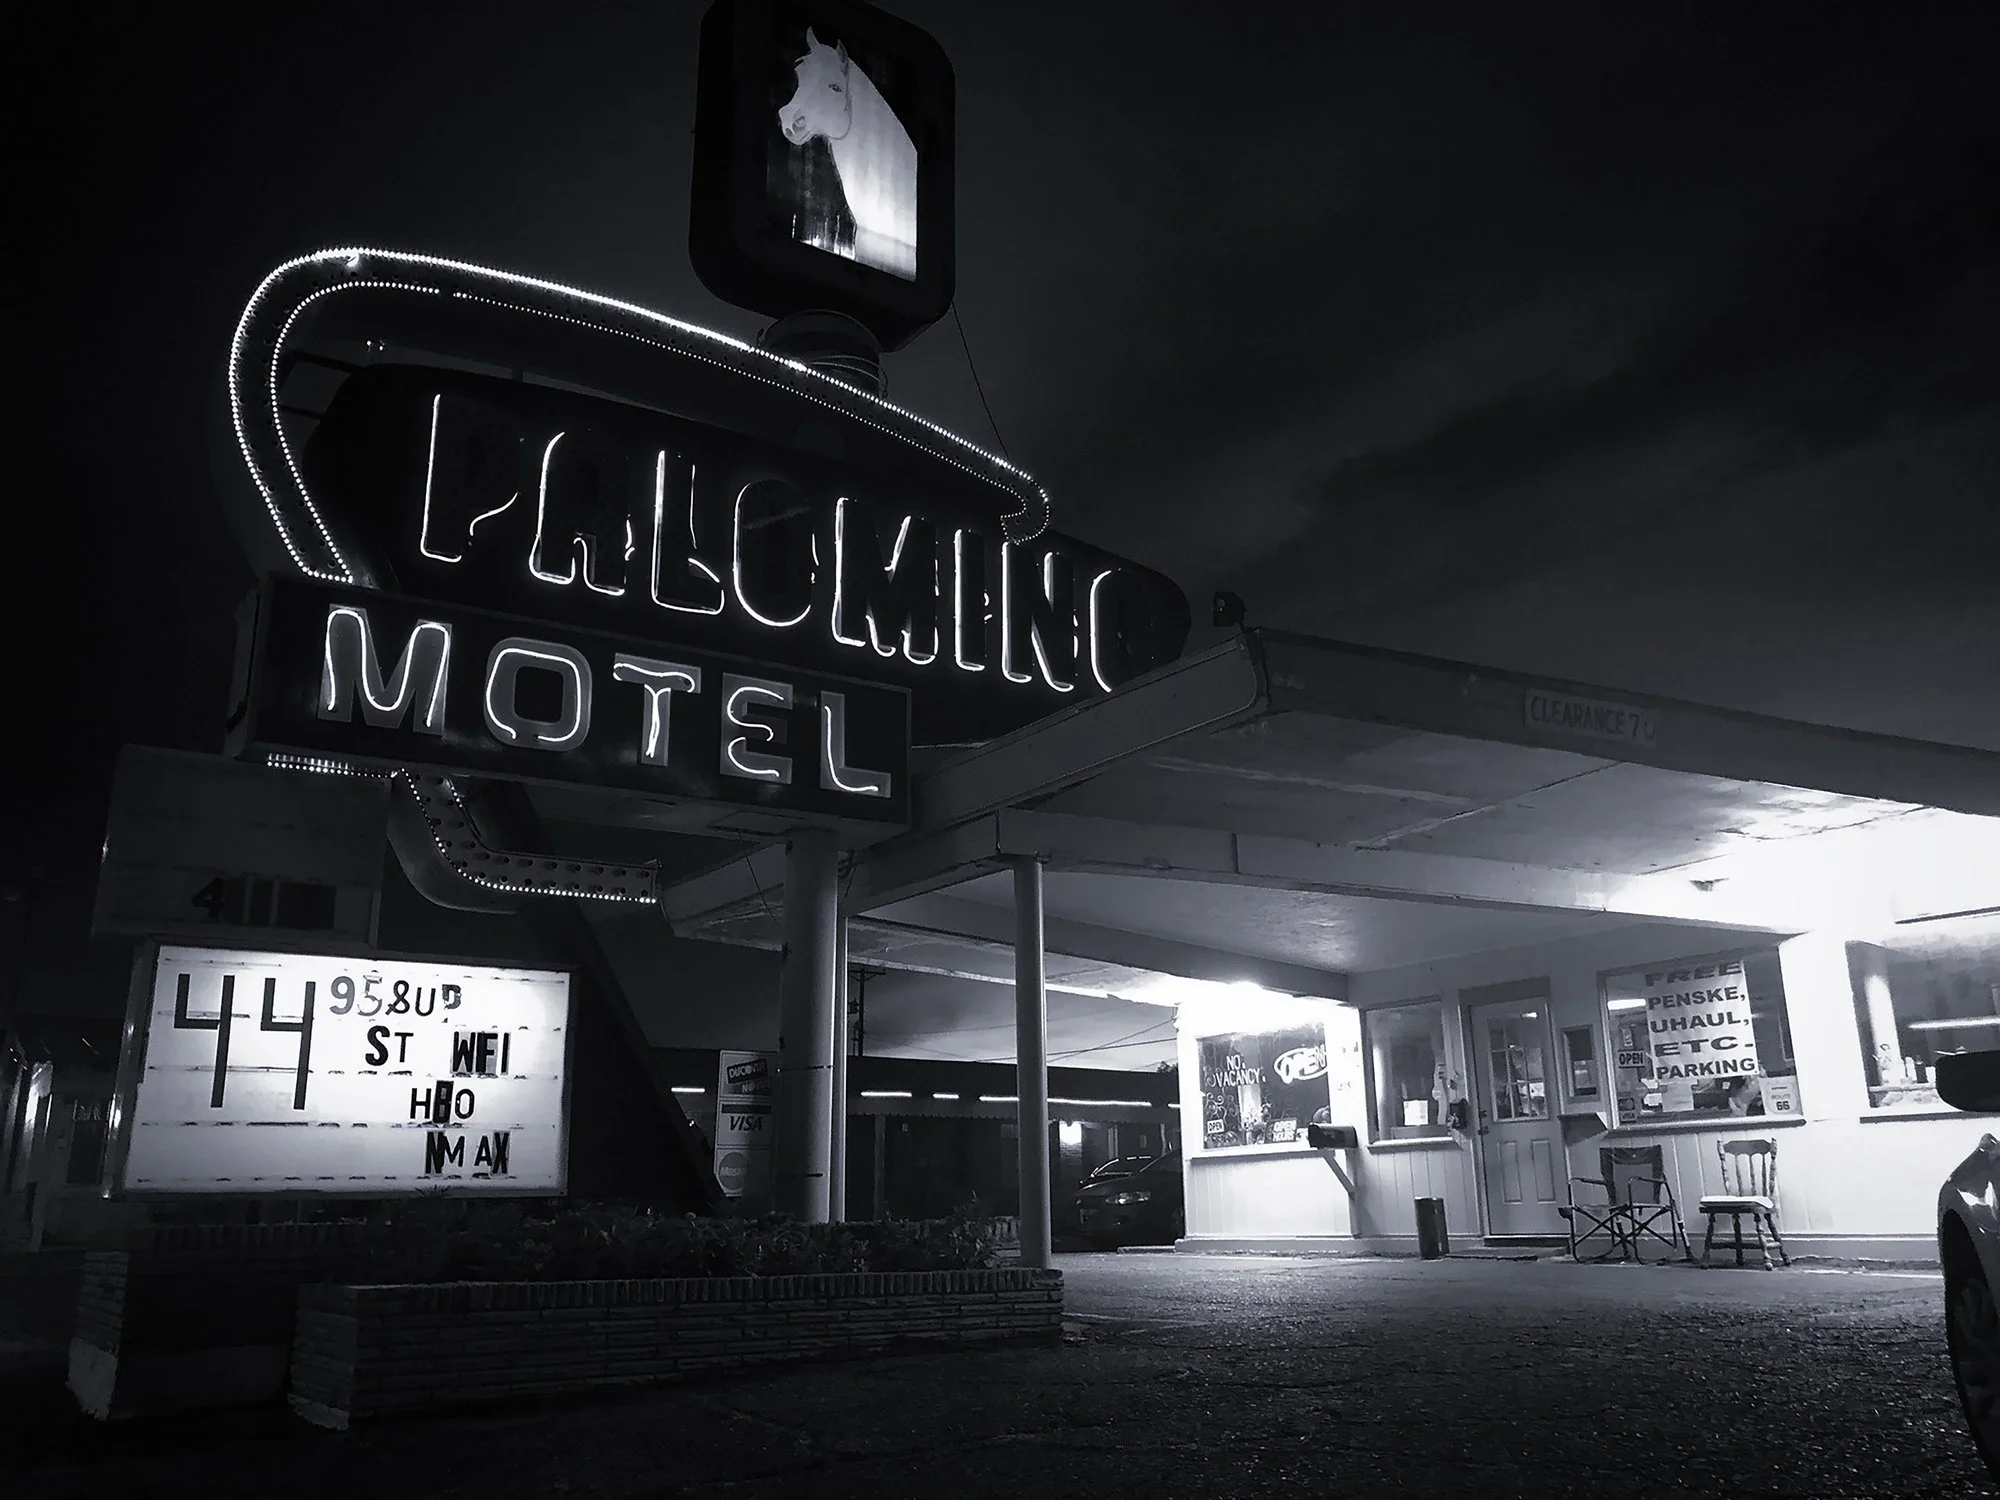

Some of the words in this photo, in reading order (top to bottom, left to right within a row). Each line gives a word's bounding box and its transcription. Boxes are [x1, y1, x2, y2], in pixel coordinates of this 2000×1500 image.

[420, 394, 1153, 693] PALOMINO
[317, 603, 891, 798] MOTEL
[1530, 695, 1626, 735] CLEARANCE
[1644, 960, 1743, 987] FREE
[1648, 986, 1746, 1010] PENSKE,
[1650, 1011, 1750, 1034] UHAUL,
[174, 974, 315, 1110] 44
[1653, 1036, 1754, 1058] ETC.
[1280, 1044, 1327, 1084] OPEN
[1618, 1052, 1644, 1065] OPEN
[410, 1080, 475, 1124] HBO
[1775, 1100, 1790, 1111] 66
[729, 1115, 763, 1131] VISA
